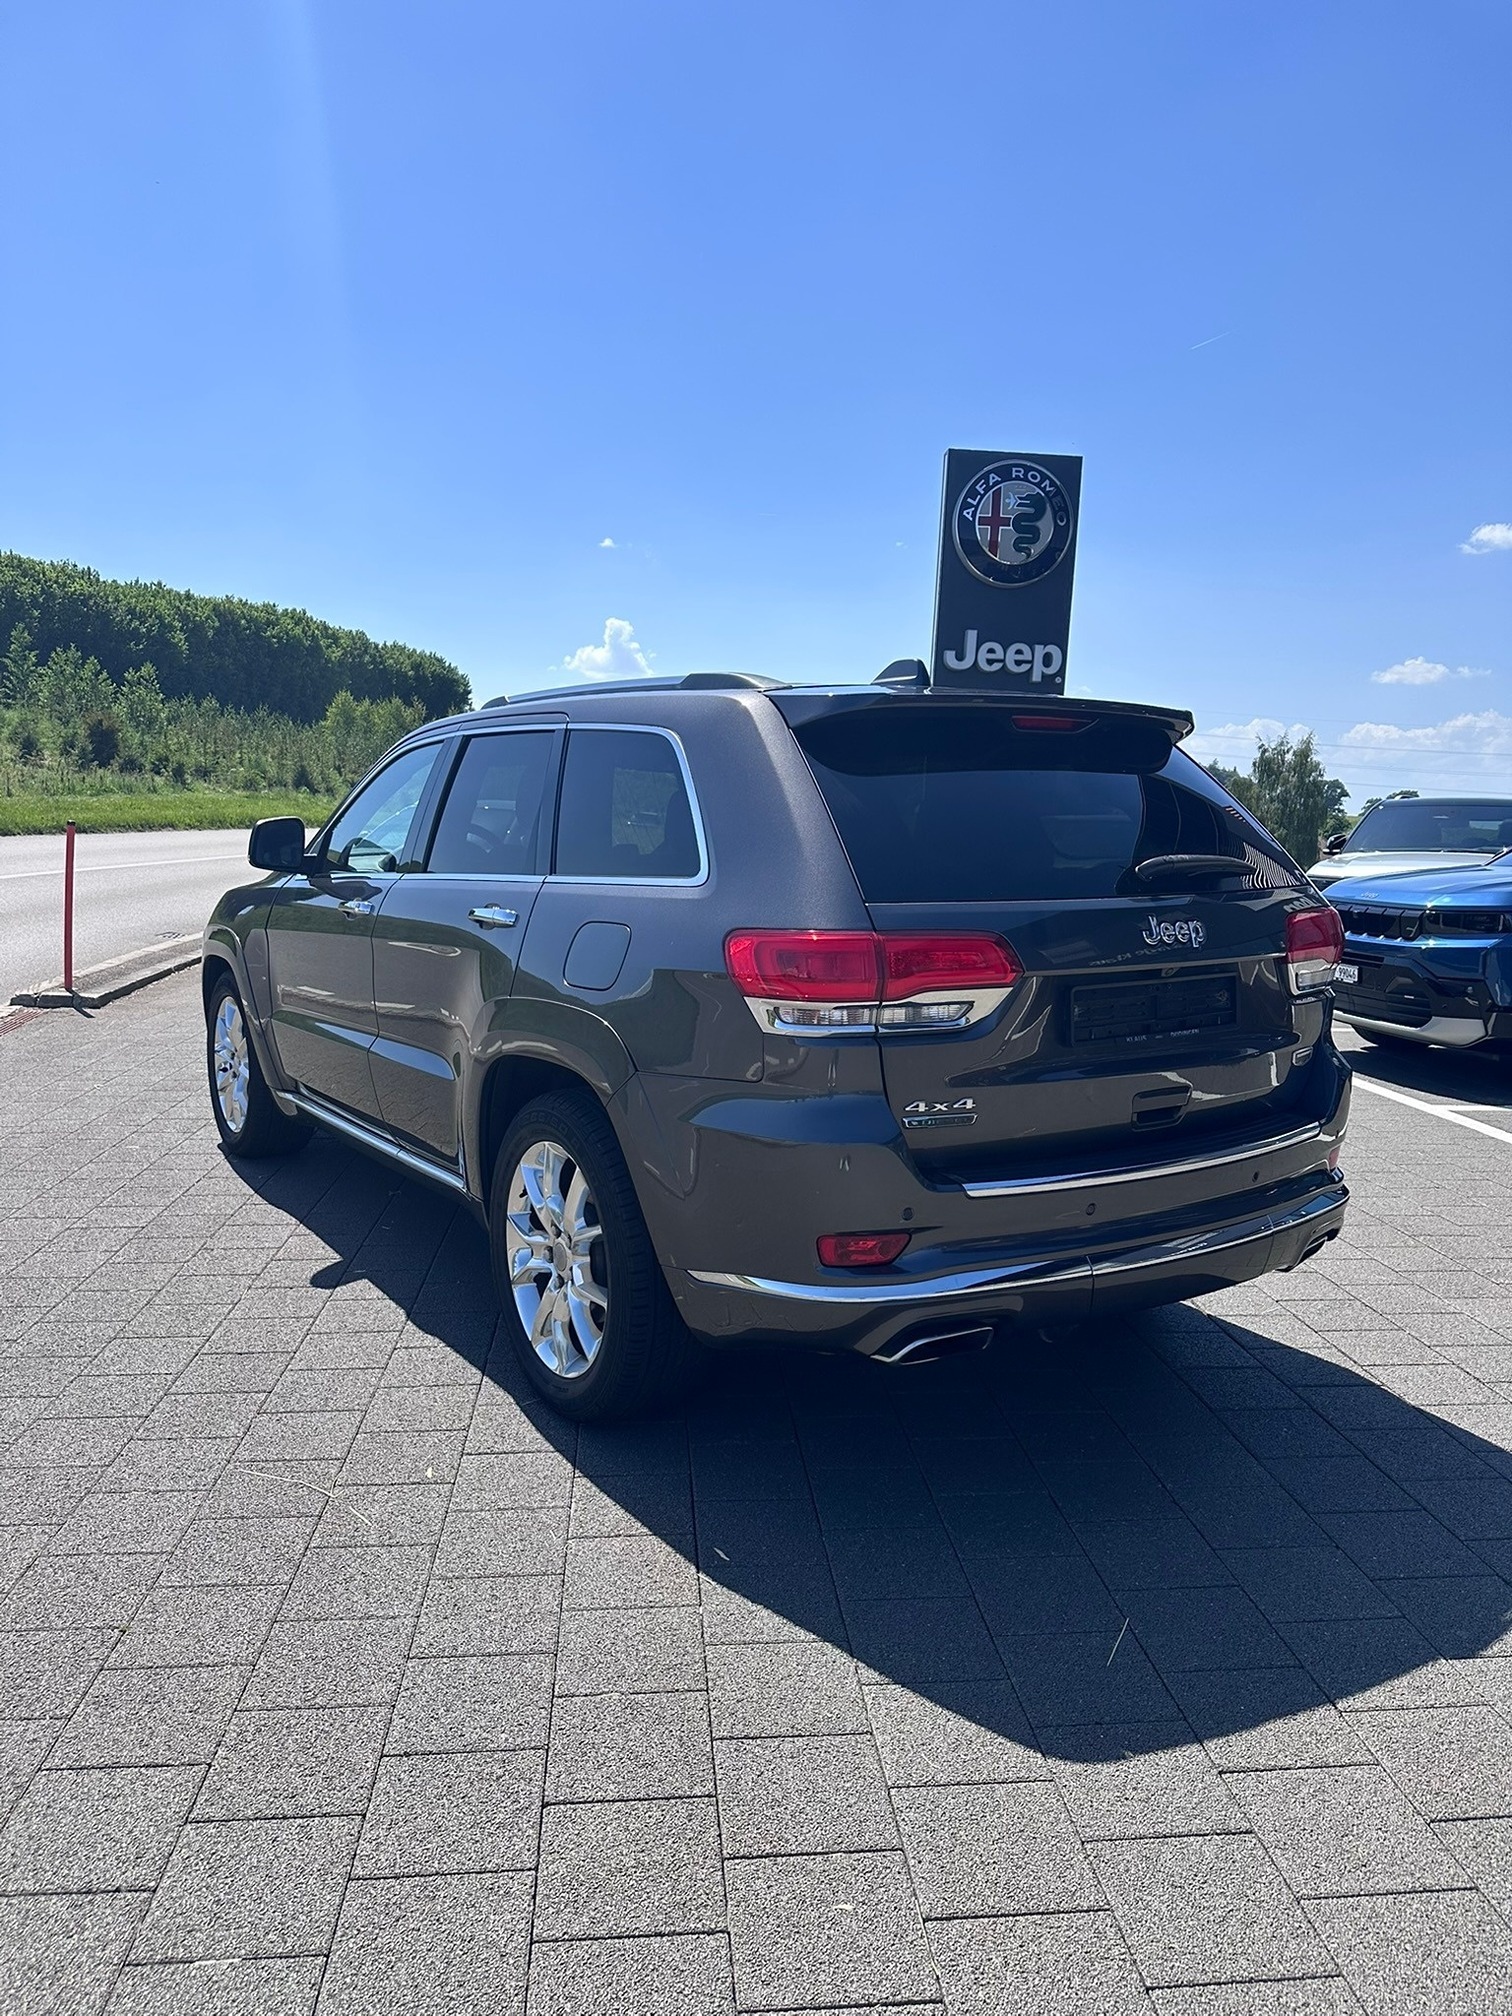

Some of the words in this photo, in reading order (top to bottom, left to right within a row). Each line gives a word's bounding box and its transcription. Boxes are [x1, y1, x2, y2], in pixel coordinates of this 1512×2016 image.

[963, 472, 1001, 521] ALFA
[1011, 467, 1067, 526] ROMEO
[943, 629, 1062, 683] Jeep
[1142, 914, 1205, 948] Jeep
[905, 1098, 976, 1112] 4x4
